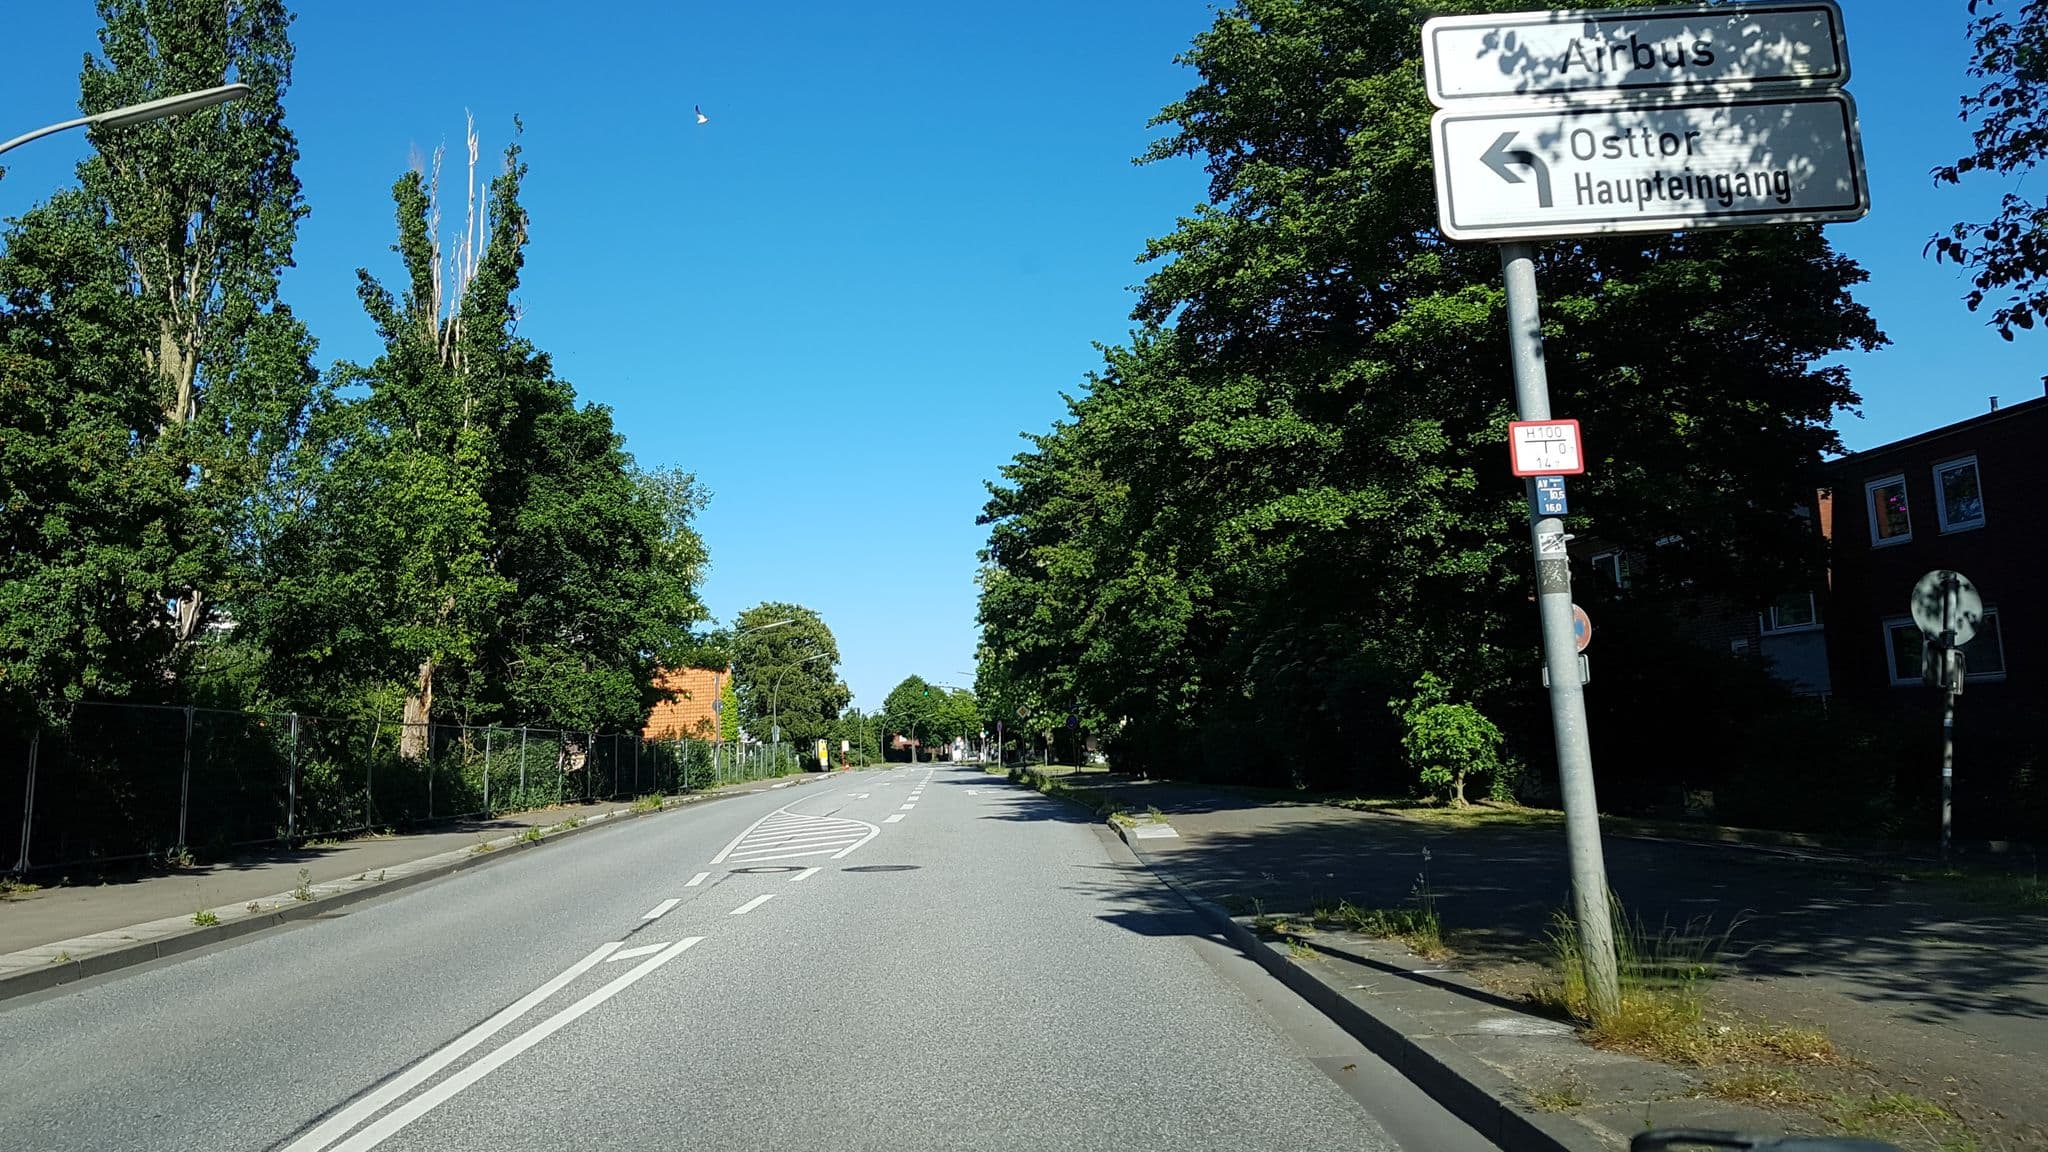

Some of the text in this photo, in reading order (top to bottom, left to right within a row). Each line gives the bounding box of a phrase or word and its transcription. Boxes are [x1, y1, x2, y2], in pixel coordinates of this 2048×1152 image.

[1560, 34, 1716, 74] Airbus
[1569, 127, 1701, 162] Osttor
[1573, 167, 1792, 212] Haupteingang
